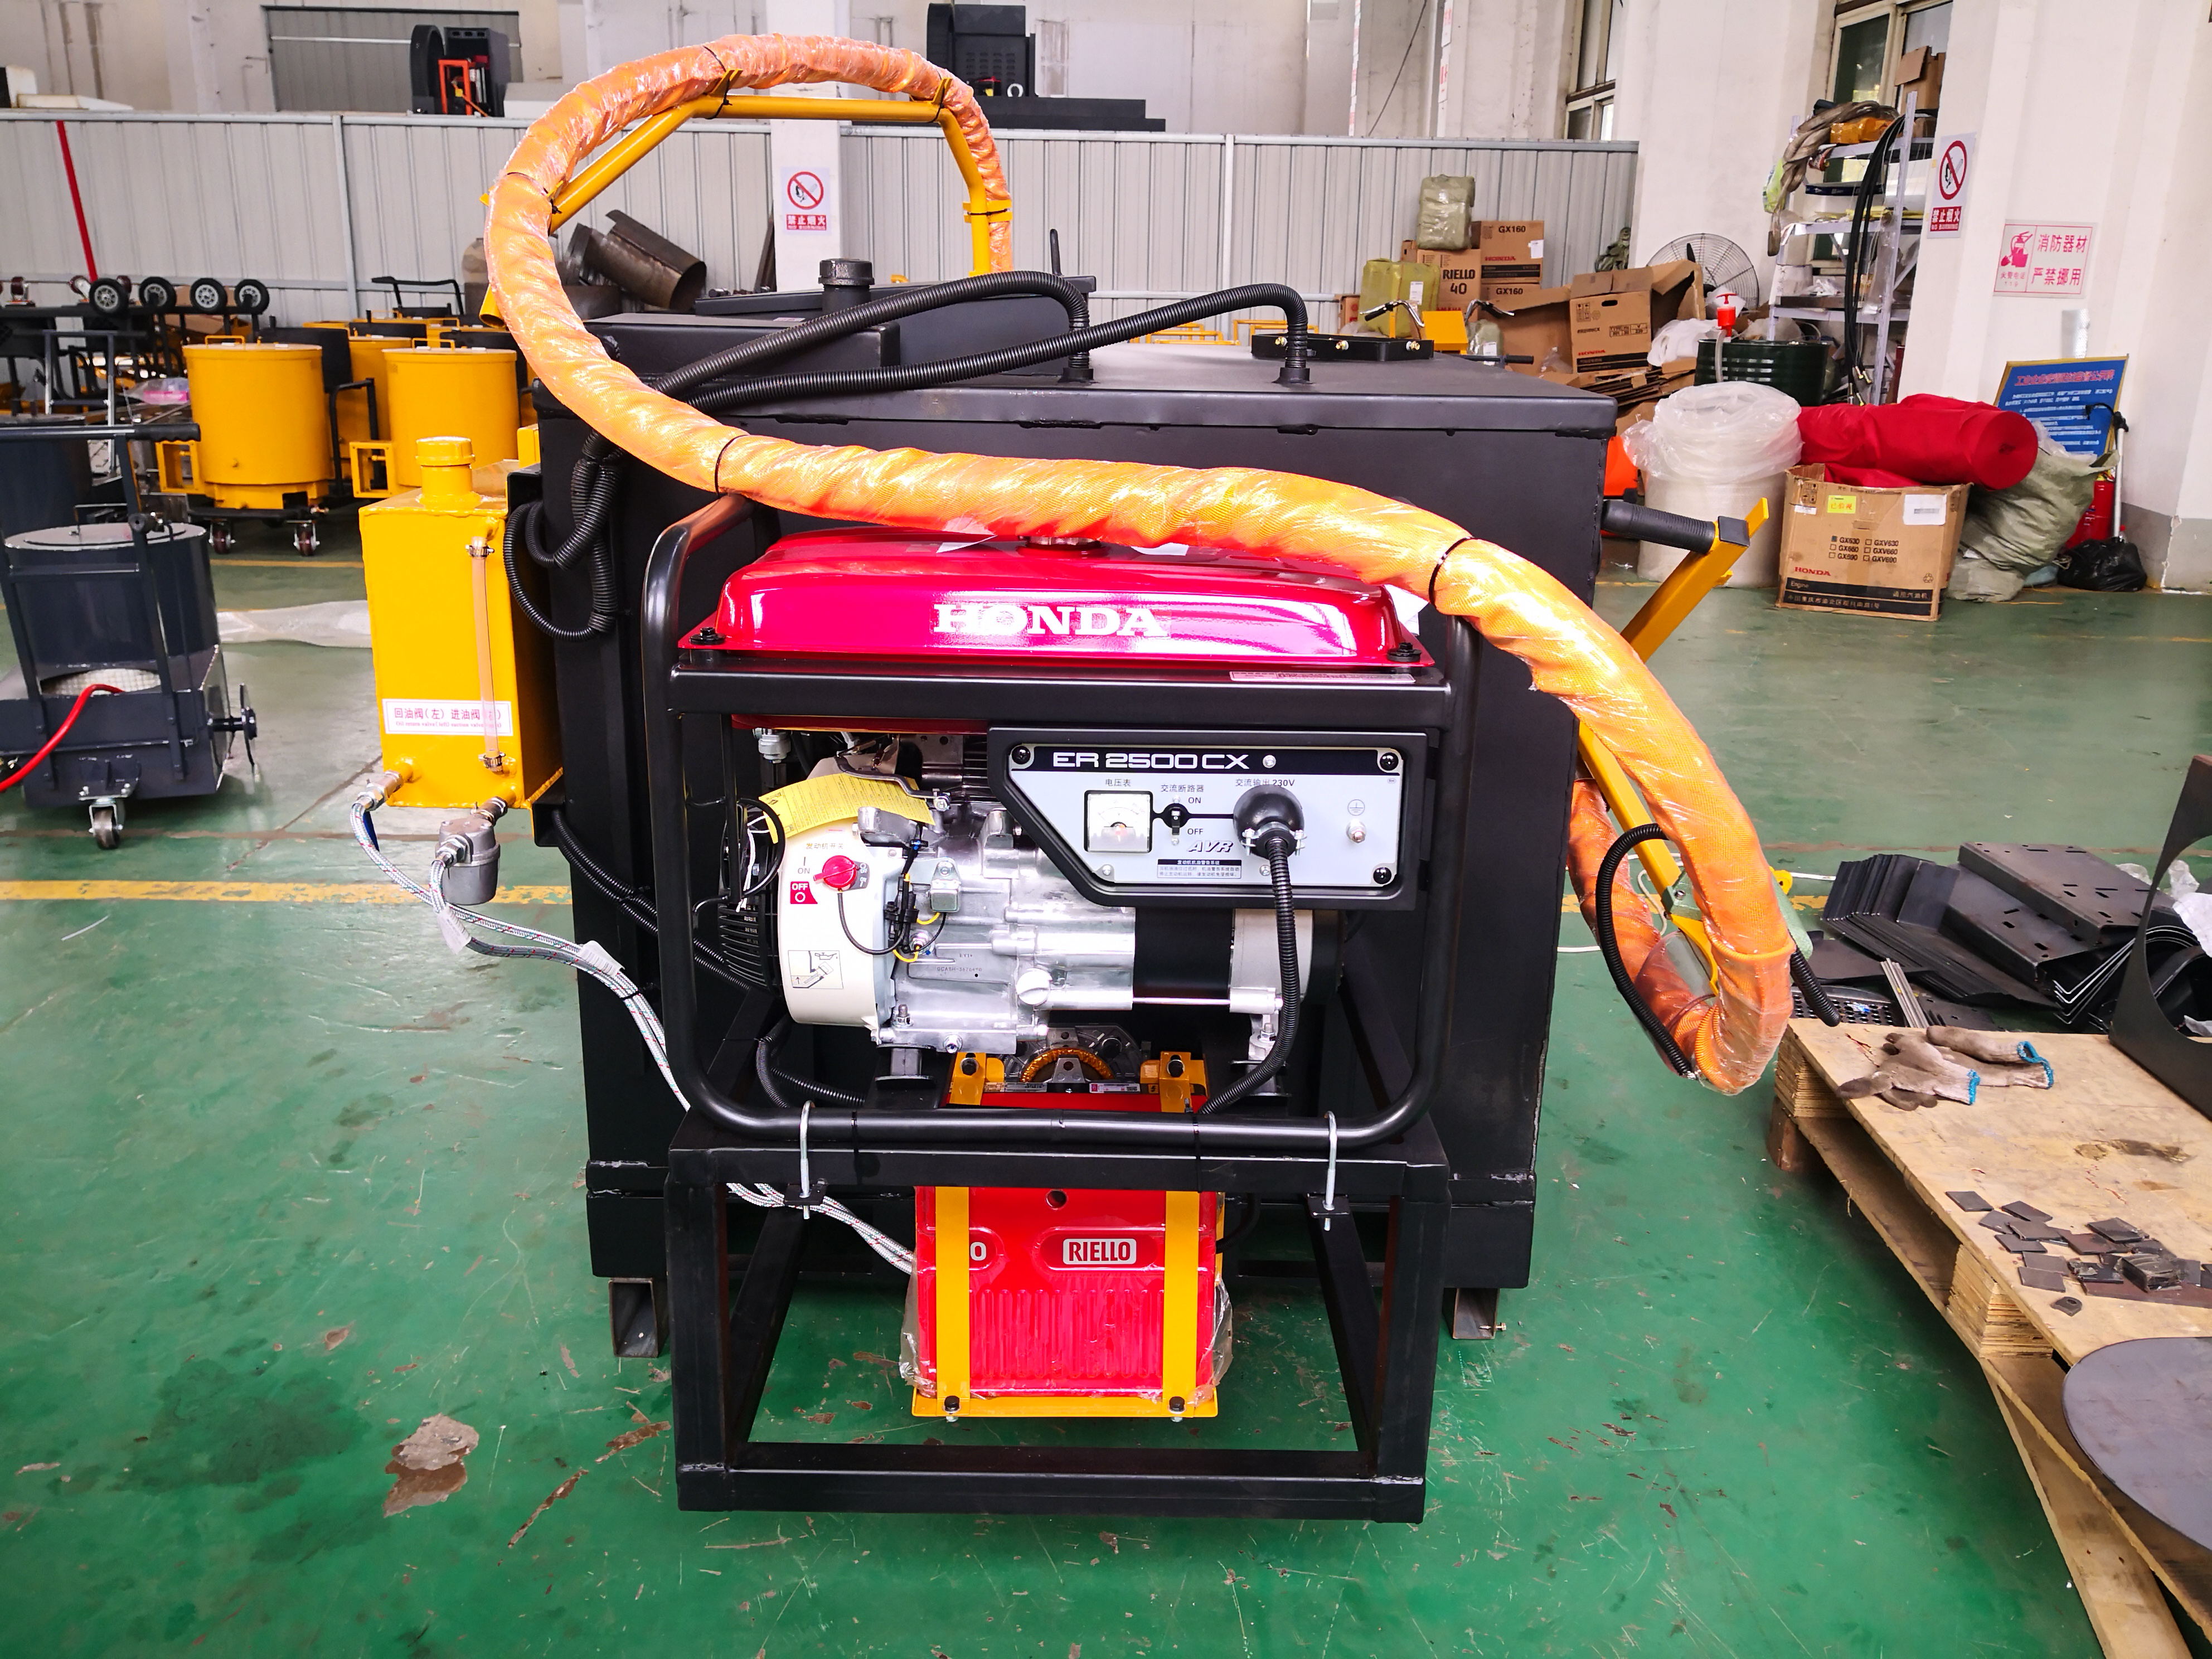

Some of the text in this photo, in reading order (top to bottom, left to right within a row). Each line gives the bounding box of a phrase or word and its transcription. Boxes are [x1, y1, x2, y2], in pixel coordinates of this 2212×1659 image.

[787, 215, 826, 226] 禁止烟火
[1932, 208, 1961, 222] 禁止烟火
[2038, 234, 2087, 253] 消防器材
[1443, 269, 1476, 279] RIELLO
[2031, 268, 2081, 285] 严禁挪用
[1451, 283, 1467, 294] 40
[1794, 566, 1831, 576] HONDA
[933, 603, 1168, 637] HONDA
[1053, 752, 1099, 768] ER
[1105, 778, 1131, 787] 电压表
[1235, 778, 1270, 787] 交流输出
[1161, 784, 1204, 793] 交流断路器
[1186, 840, 1234, 853] AVR
[792, 882, 808, 891] OFF
[1069, 1241, 1131, 1262] RIELLO
